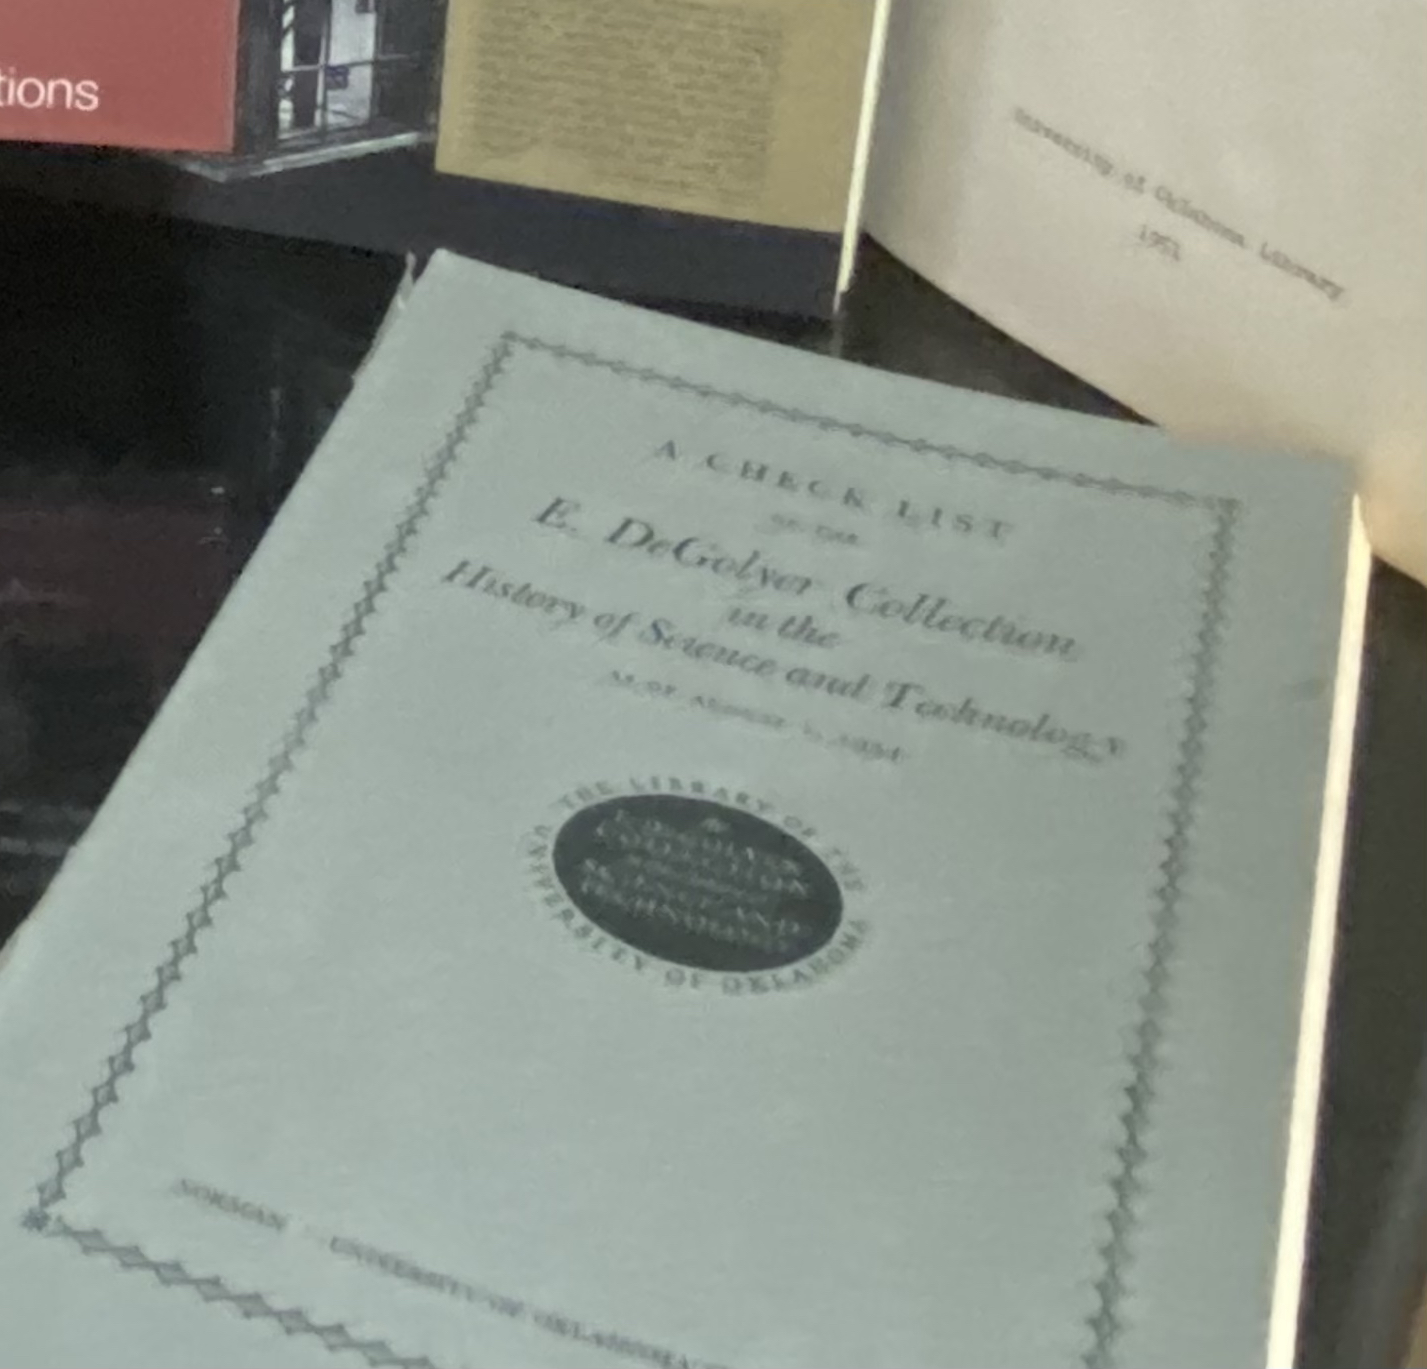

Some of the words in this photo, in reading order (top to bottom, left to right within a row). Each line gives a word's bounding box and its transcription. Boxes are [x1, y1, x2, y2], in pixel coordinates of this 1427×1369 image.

[656, 440, 676, 461] A
[706, 452, 864, 508] CHECK
[897, 500, 1013, 538] LIST
[533, 497, 581, 534] E.
[606, 516, 819, 597] DeGolyer
[845, 582, 1079, 663] Collection
[441, 560, 586, 626] History
[593, 612, 640, 643] of
[638, 618, 778, 677] Science
[785, 667, 871, 700] and
[885, 681, 1125, 765] Technology
[728, 607, 769, 631] in
[778, 614, 841, 648] the
[629, 775, 777, 812] LIBRARY
[665, 968, 702, 991] OF
[721, 919, 868, 995] OKLAHOMA
